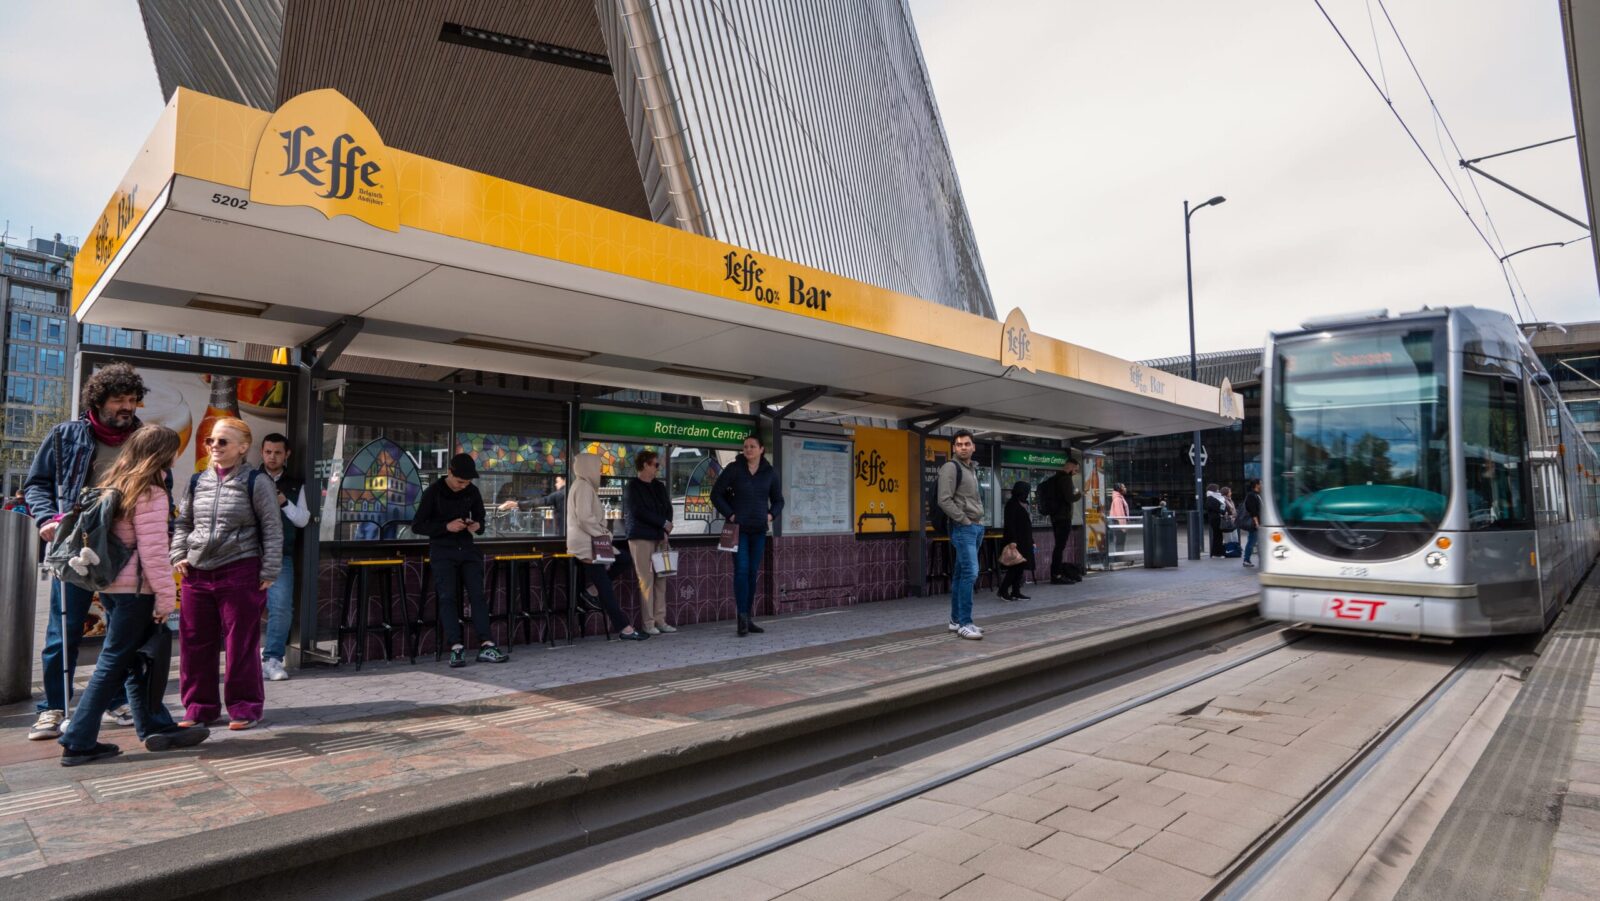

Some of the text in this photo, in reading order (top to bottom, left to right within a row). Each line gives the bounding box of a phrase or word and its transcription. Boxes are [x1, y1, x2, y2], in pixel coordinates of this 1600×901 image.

[279, 125, 381, 200] Leffe
[211, 193, 249, 210] 5202
[723, 251, 832, 312] Leffe Bar
[1007, 326, 1030, 361] Leffe
[654, 421, 709, 438] Rotterdam
[855, 449, 887, 487] Leffe
[1325, 597, 1387, 622] RET
